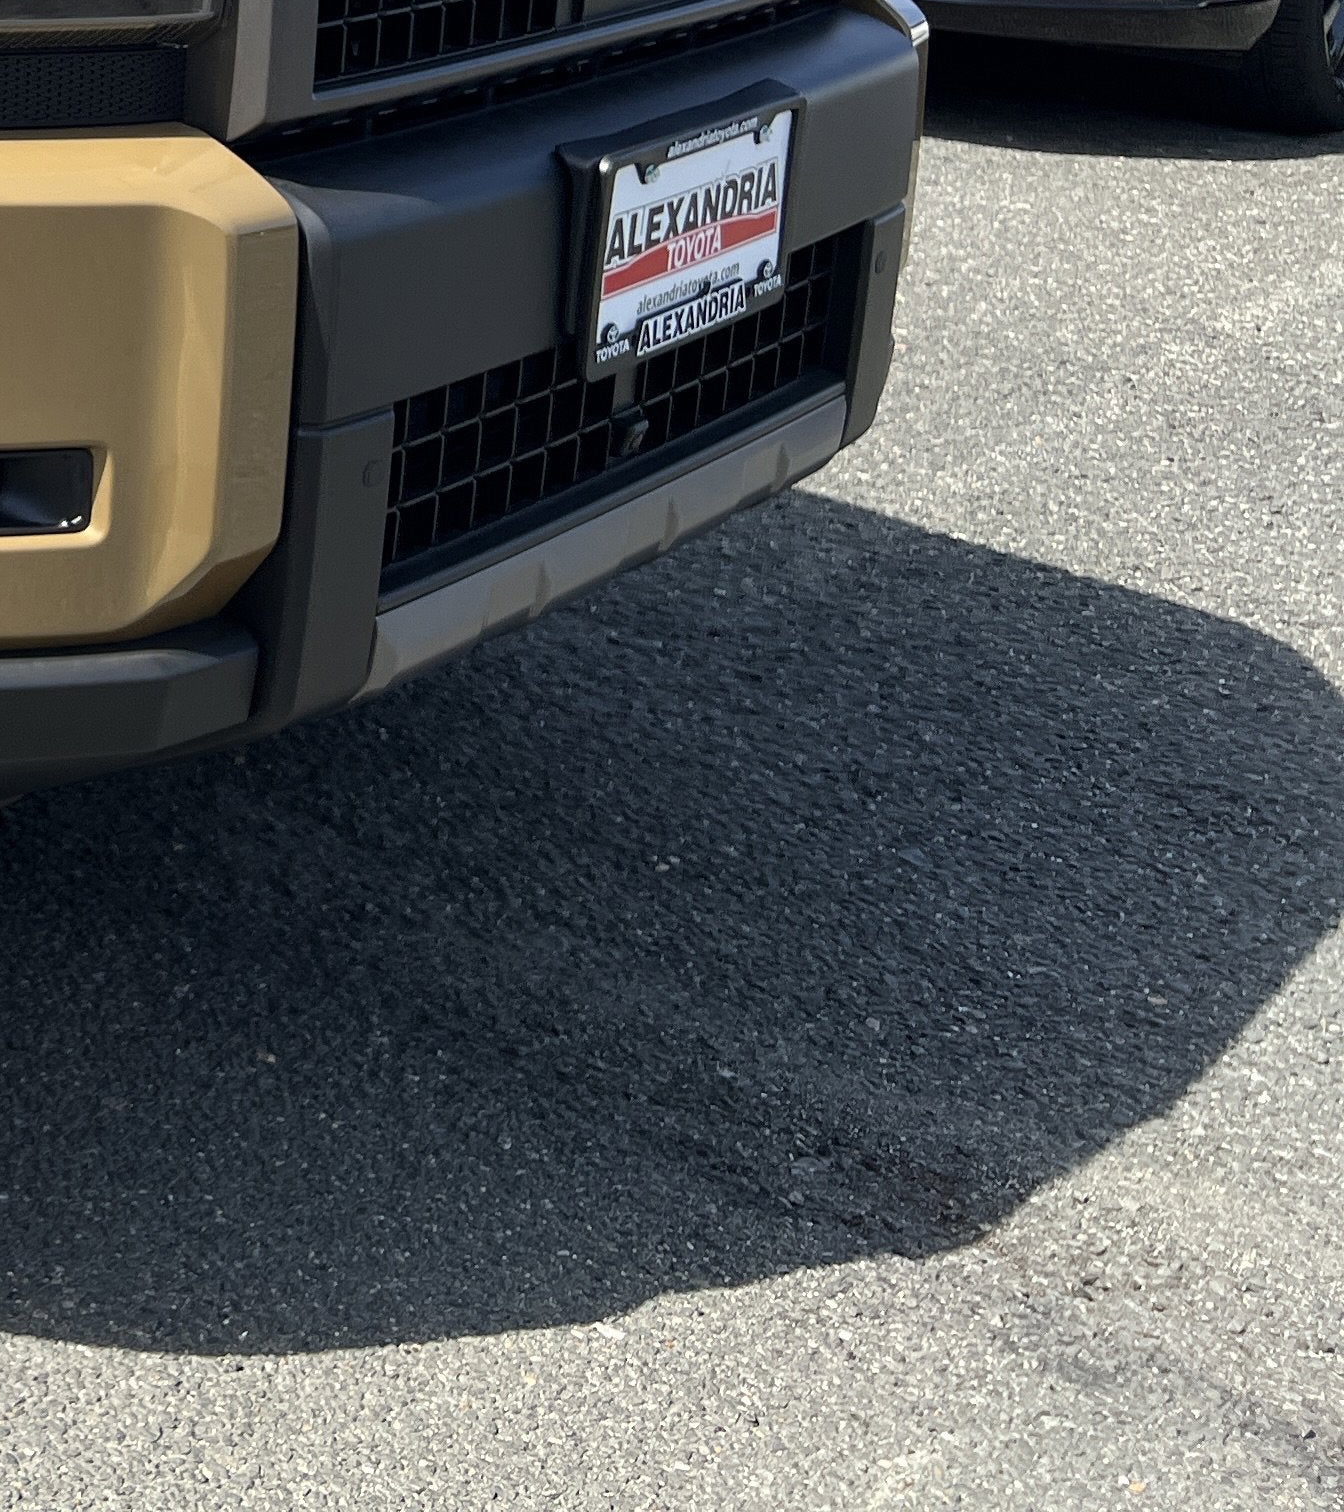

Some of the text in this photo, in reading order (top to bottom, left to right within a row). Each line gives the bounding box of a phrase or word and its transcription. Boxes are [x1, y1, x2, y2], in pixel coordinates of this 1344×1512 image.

[605, 161, 778, 268] ALEXANDRIA
[667, 225, 723, 272] TOYOTA
[754, 275, 782, 298] TOYOTA
[637, 282, 746, 356] ALEXANDRIA
[596, 338, 630, 364] TOYOTA
